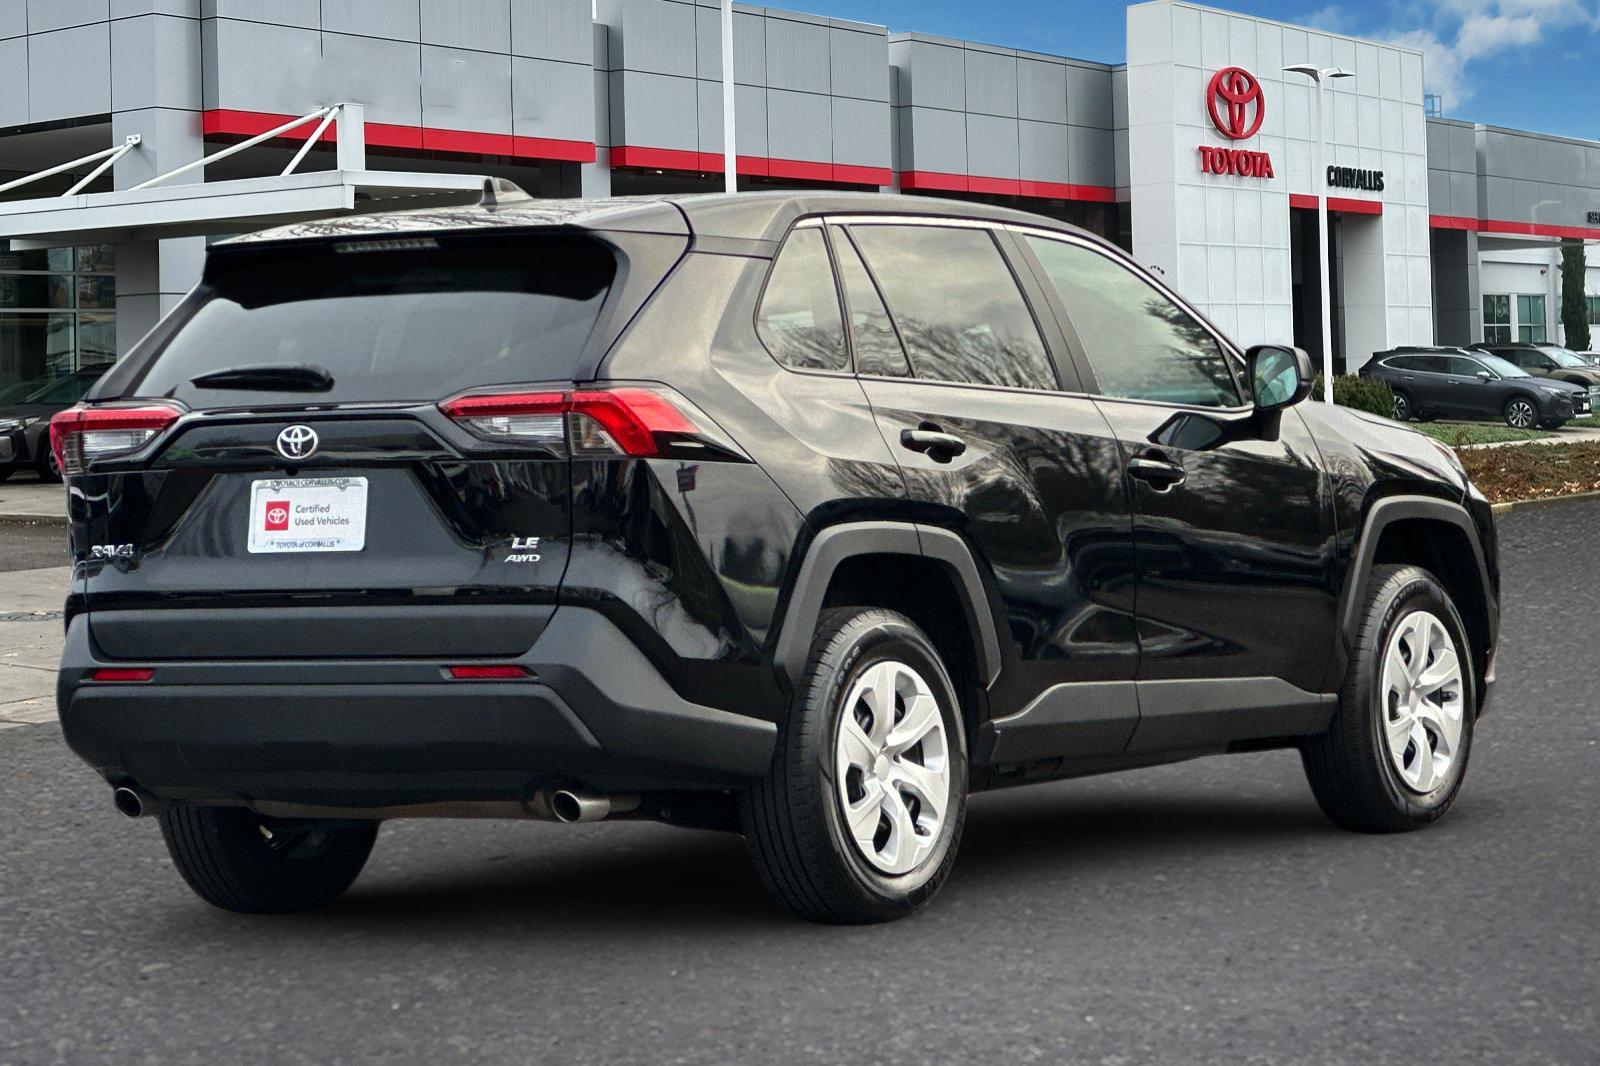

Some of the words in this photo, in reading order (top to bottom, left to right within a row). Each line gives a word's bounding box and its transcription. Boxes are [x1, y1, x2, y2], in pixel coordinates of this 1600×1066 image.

[1199, 146, 1274, 179] TOYOTA
[1327, 165, 1384, 191] CORVALLIS
[295, 504, 331, 514] Certified
[294, 518, 315, 526] Used
[317, 517, 350, 526] Vehicles
[512, 536, 540, 549] LE
[91, 543, 134, 558] RAV4
[504, 554, 541, 563] AWD
